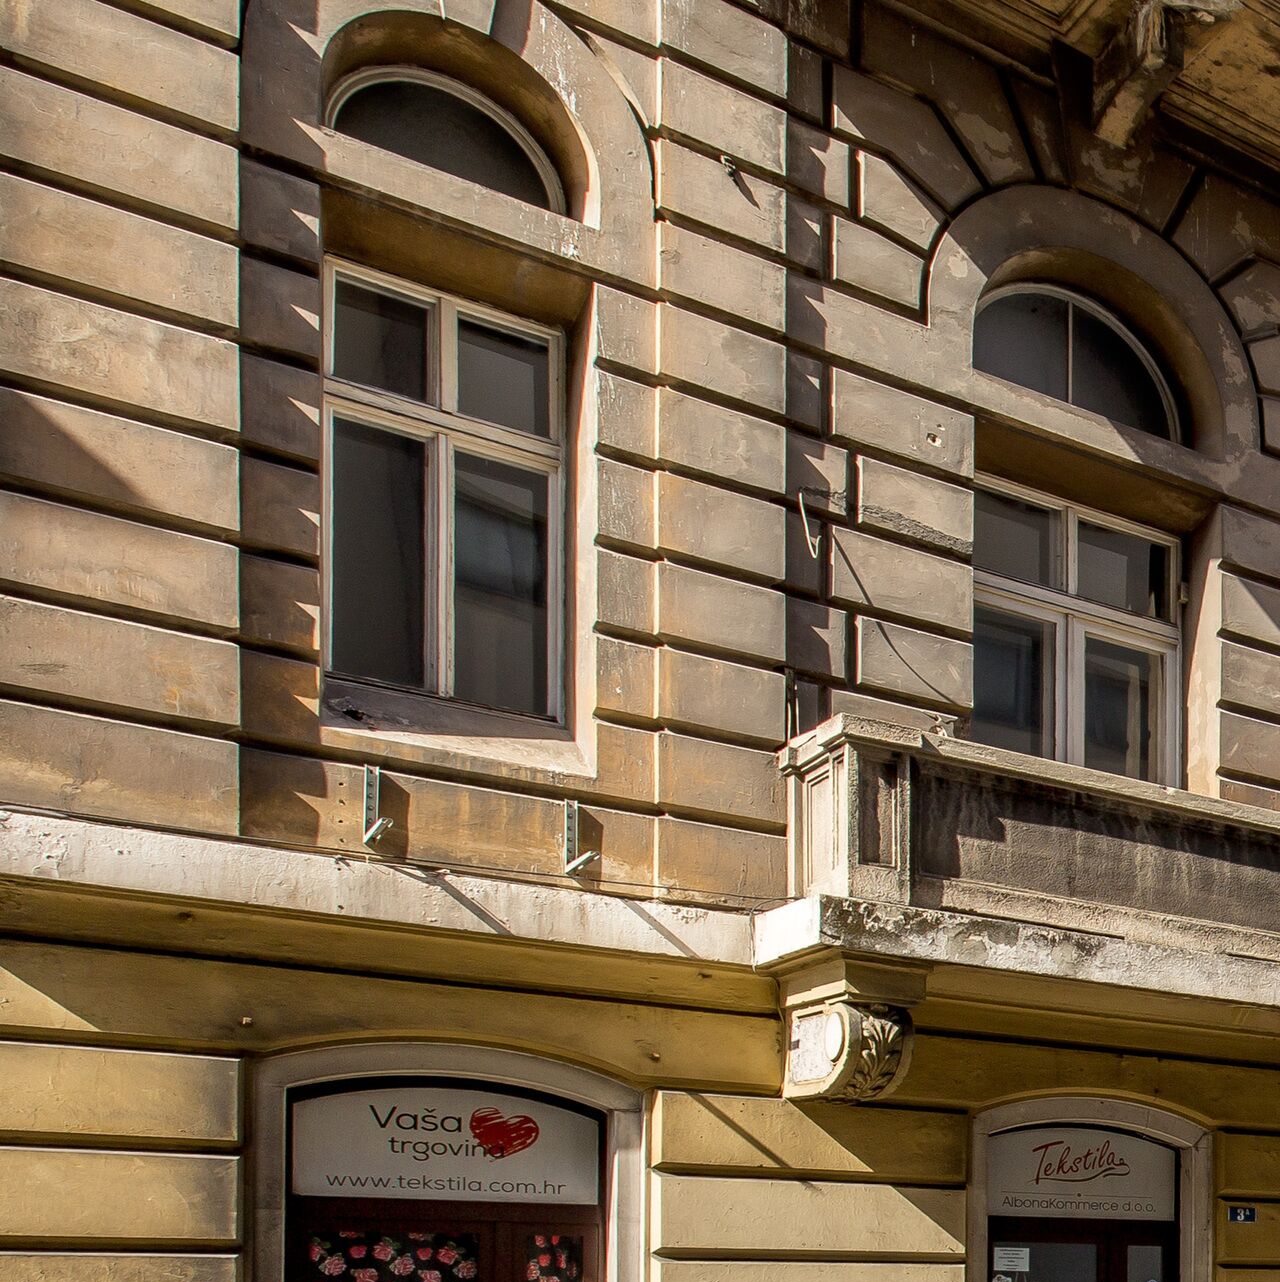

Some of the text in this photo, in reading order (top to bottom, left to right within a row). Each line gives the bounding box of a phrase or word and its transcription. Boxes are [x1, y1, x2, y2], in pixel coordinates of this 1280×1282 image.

[369, 1104, 463, 1133] Vaša
[388, 1136, 508, 1163] trgovina
[1030, 1140, 1131, 1185] Tekstila
[325, 1174, 567, 1196] www.tekstila.com.hr
[1001, 1196, 1157, 1213] AlbonaKommerce d.o.o.
